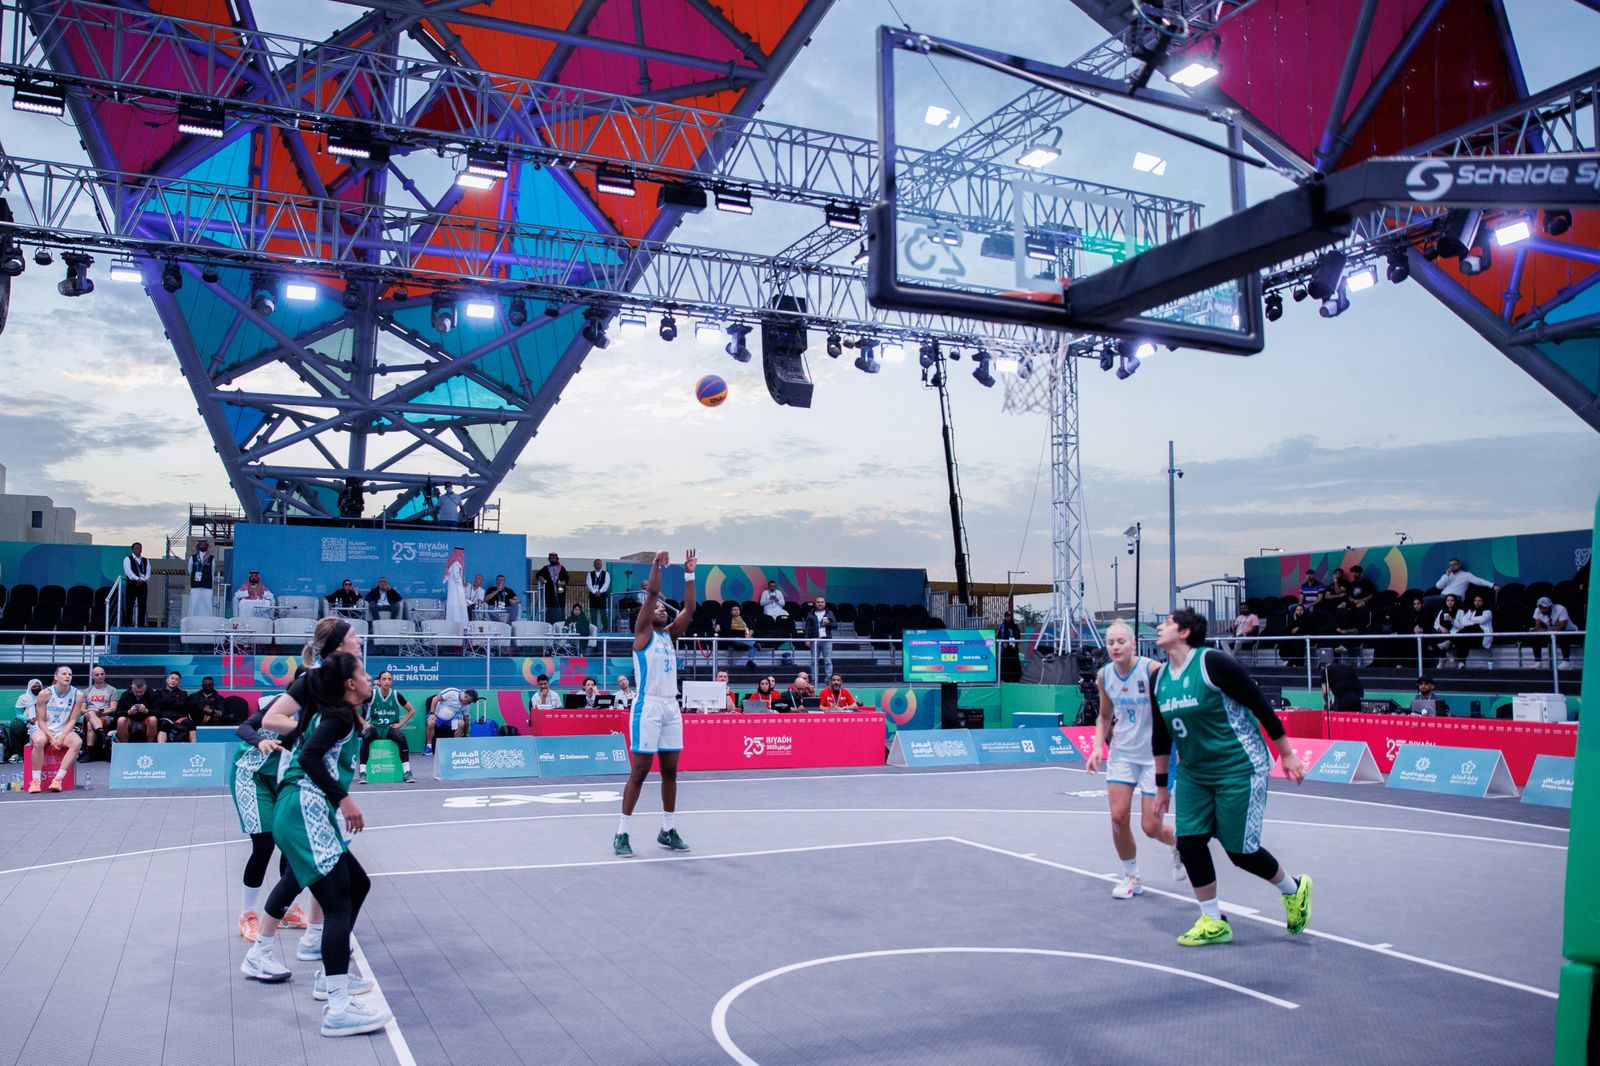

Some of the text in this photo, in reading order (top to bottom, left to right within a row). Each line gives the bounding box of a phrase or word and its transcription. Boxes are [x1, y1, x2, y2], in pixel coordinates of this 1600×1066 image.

[1456, 164, 1569, 186] Schelde
[393, 674, 440, 682] NE NATION
[1170, 694, 1200, 712] Arabia
[1172, 717, 1188, 738] 9
[766, 735, 793, 744] RIYADH
[452, 750, 480, 758] المسار
[452, 757, 480, 766] الرياضي
